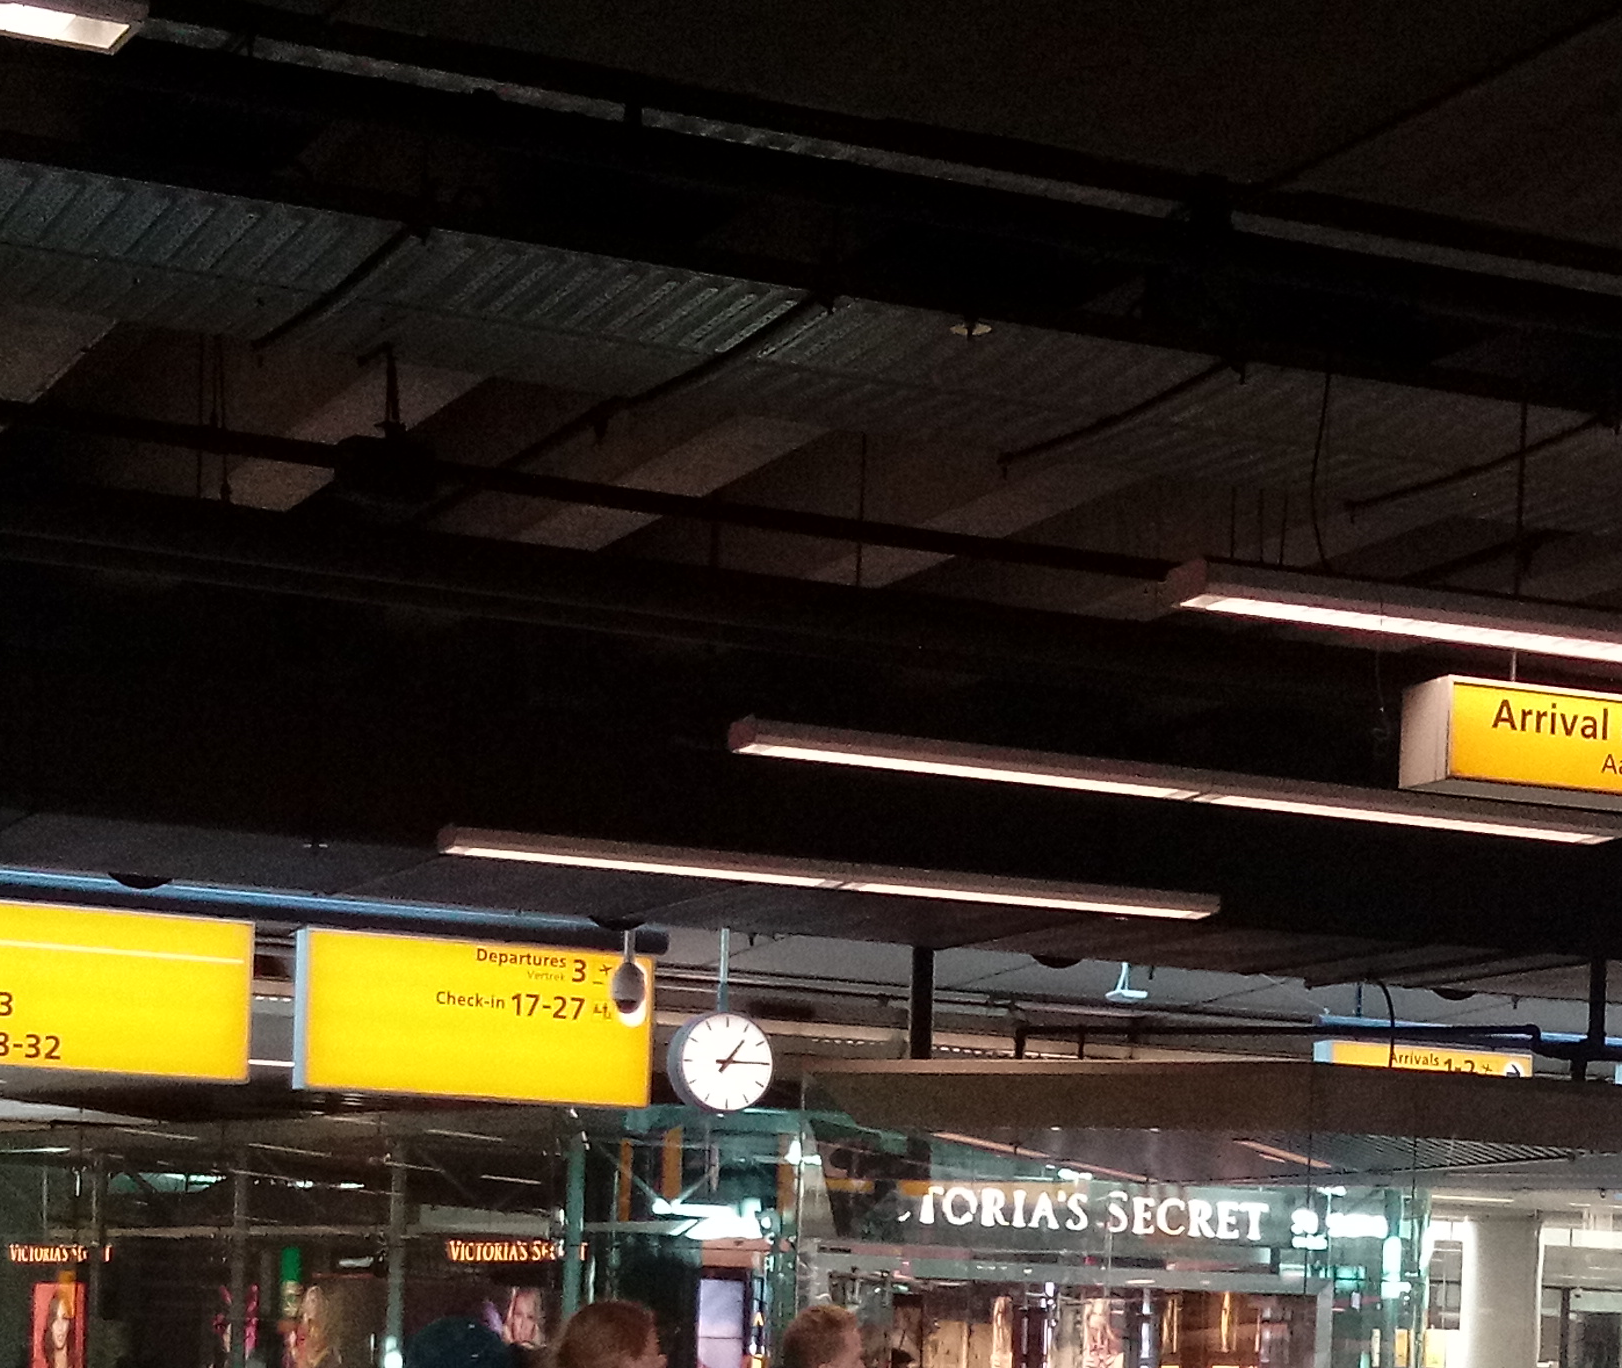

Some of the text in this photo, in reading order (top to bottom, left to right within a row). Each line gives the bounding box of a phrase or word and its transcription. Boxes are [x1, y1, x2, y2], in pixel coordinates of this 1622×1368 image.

[1491, 698, 1609, 741] Arrival
[476, 947, 587, 984] Departures 3
[436, 990, 587, 1021] Check-in 17-27
[1391, 1051, 1440, 1067] Arrivals
[898, 1186, 1270, 1241] TORIA'S SECRET
[8, 1243, 68, 1263] VICTORIA'S
[448, 1239, 529, 1261] VICTORIA'S
